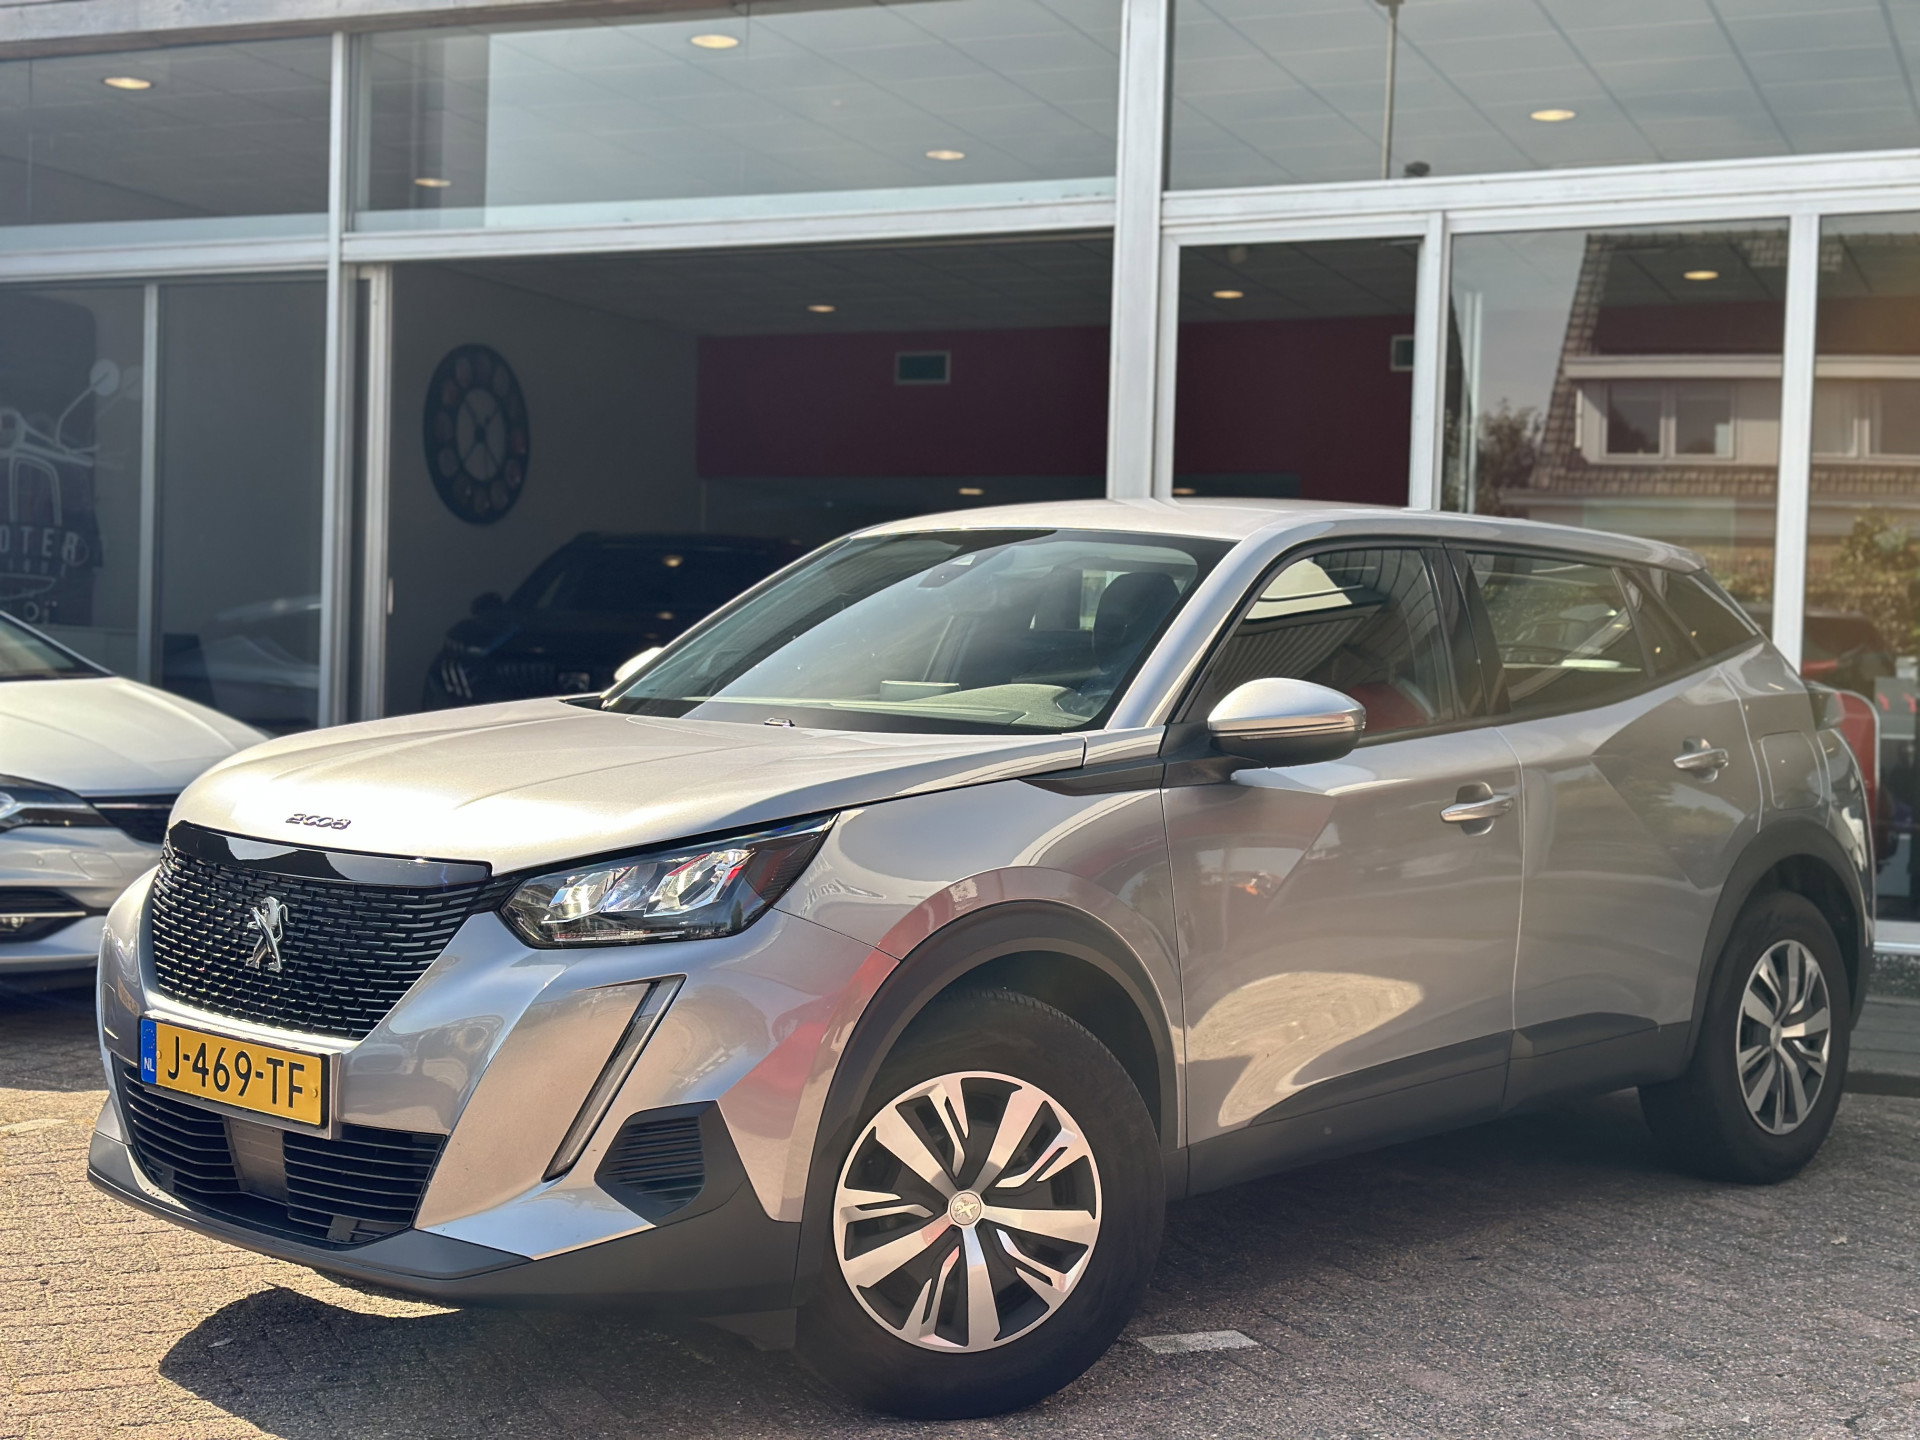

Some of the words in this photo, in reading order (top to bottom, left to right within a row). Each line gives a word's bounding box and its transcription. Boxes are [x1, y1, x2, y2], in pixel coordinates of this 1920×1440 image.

[285, 813, 352, 830] 2008
[143, 1057, 155, 1072] NL
[167, 1036, 305, 1109] J-469-TF
